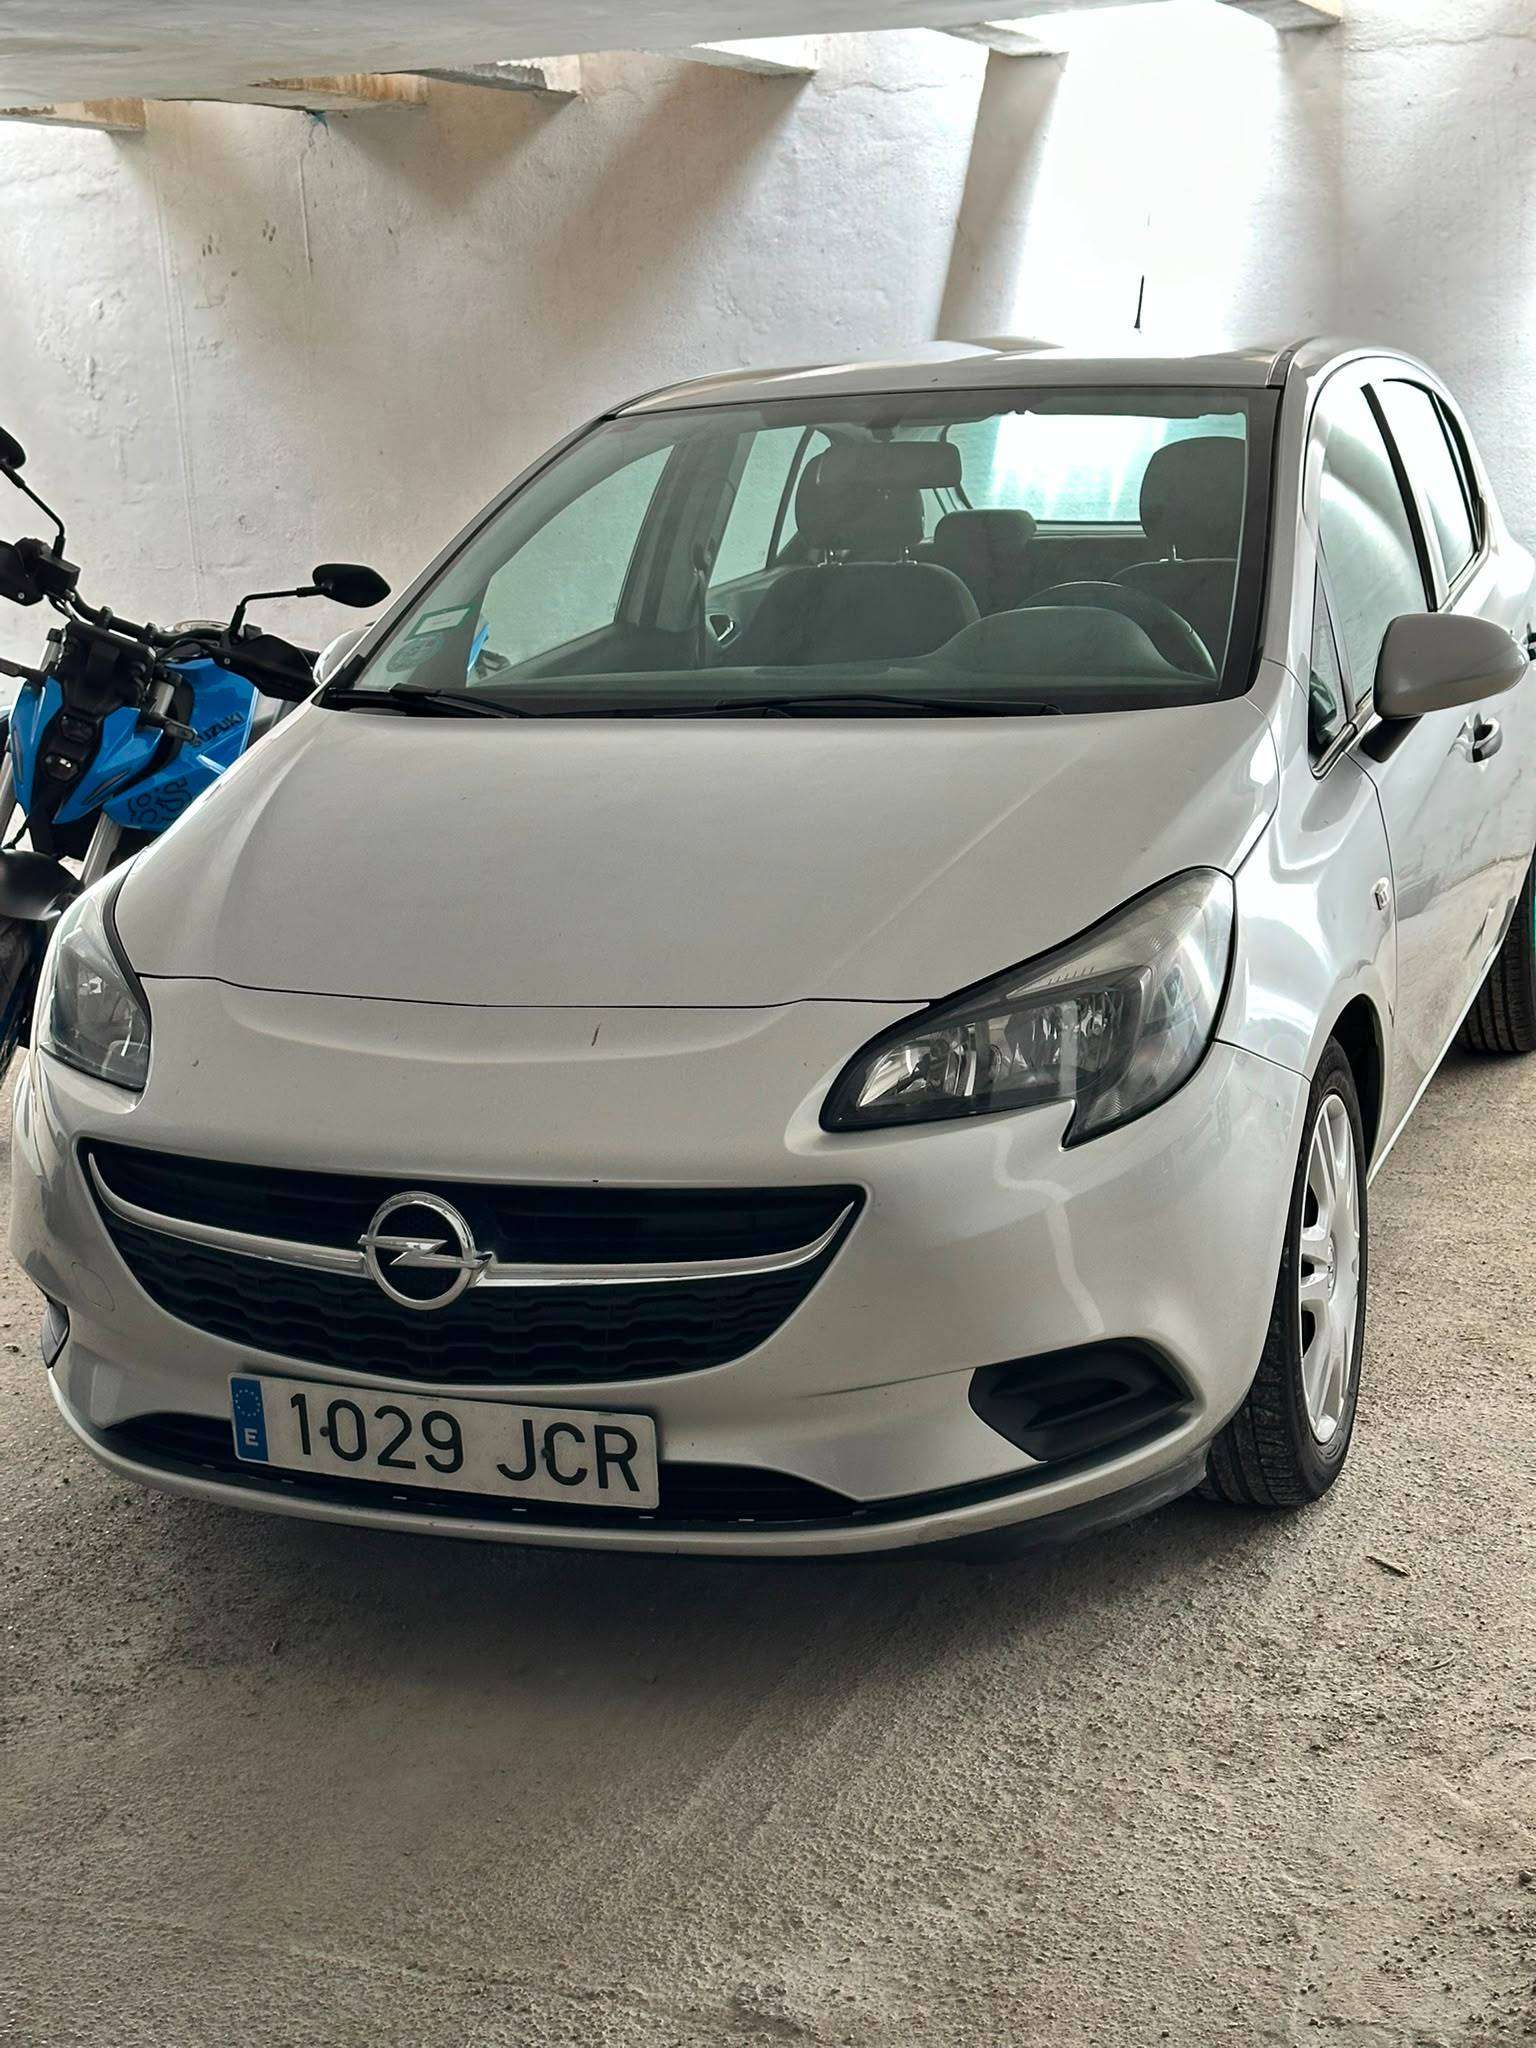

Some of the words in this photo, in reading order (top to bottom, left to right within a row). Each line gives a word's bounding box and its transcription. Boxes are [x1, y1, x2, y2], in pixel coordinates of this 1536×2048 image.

[244, 1427, 259, 1446] E
[290, 1393, 464, 1474] 1029
[496, 1419, 641, 1492] JCR
